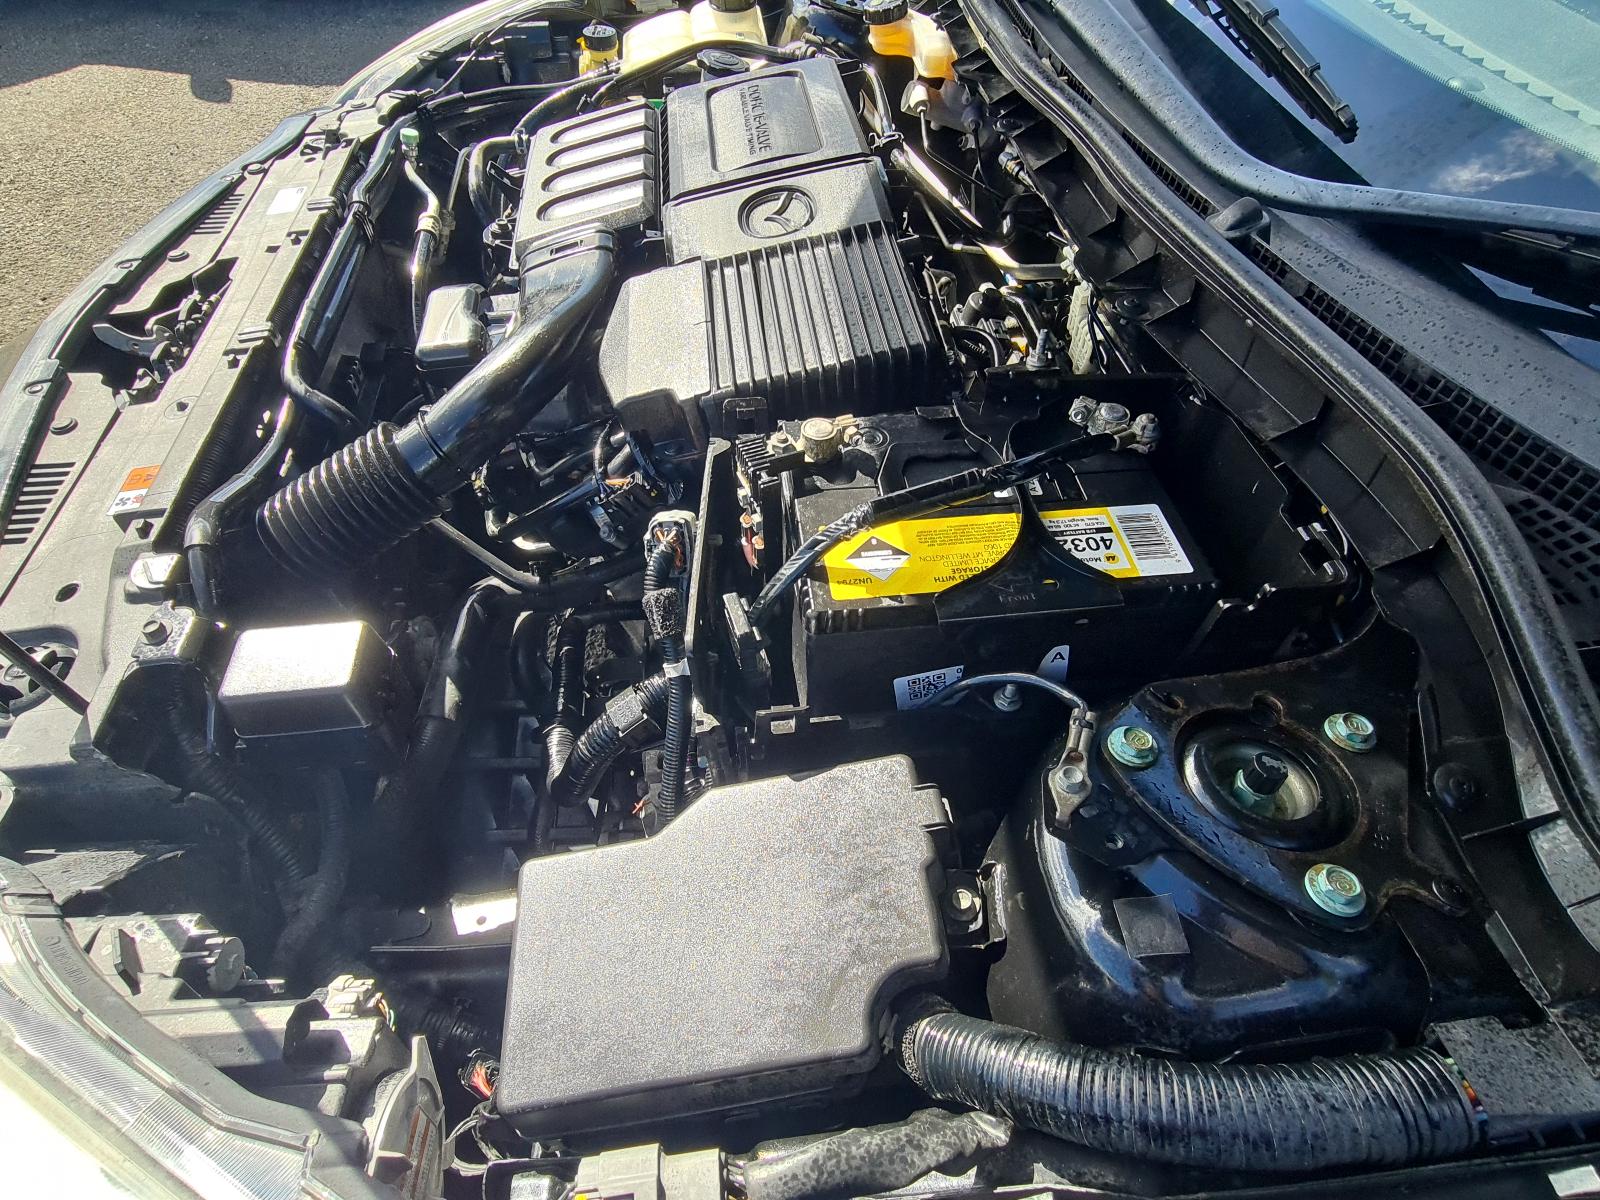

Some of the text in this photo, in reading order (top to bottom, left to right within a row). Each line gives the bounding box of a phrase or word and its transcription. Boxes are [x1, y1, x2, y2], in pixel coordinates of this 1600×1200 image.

[748, 84, 764, 113] DOHC
[919, 553, 970, 562] WELLINGTON
[943, 556, 999, 567] ERVICE LIMITED
[934, 575, 958, 583] WITH
